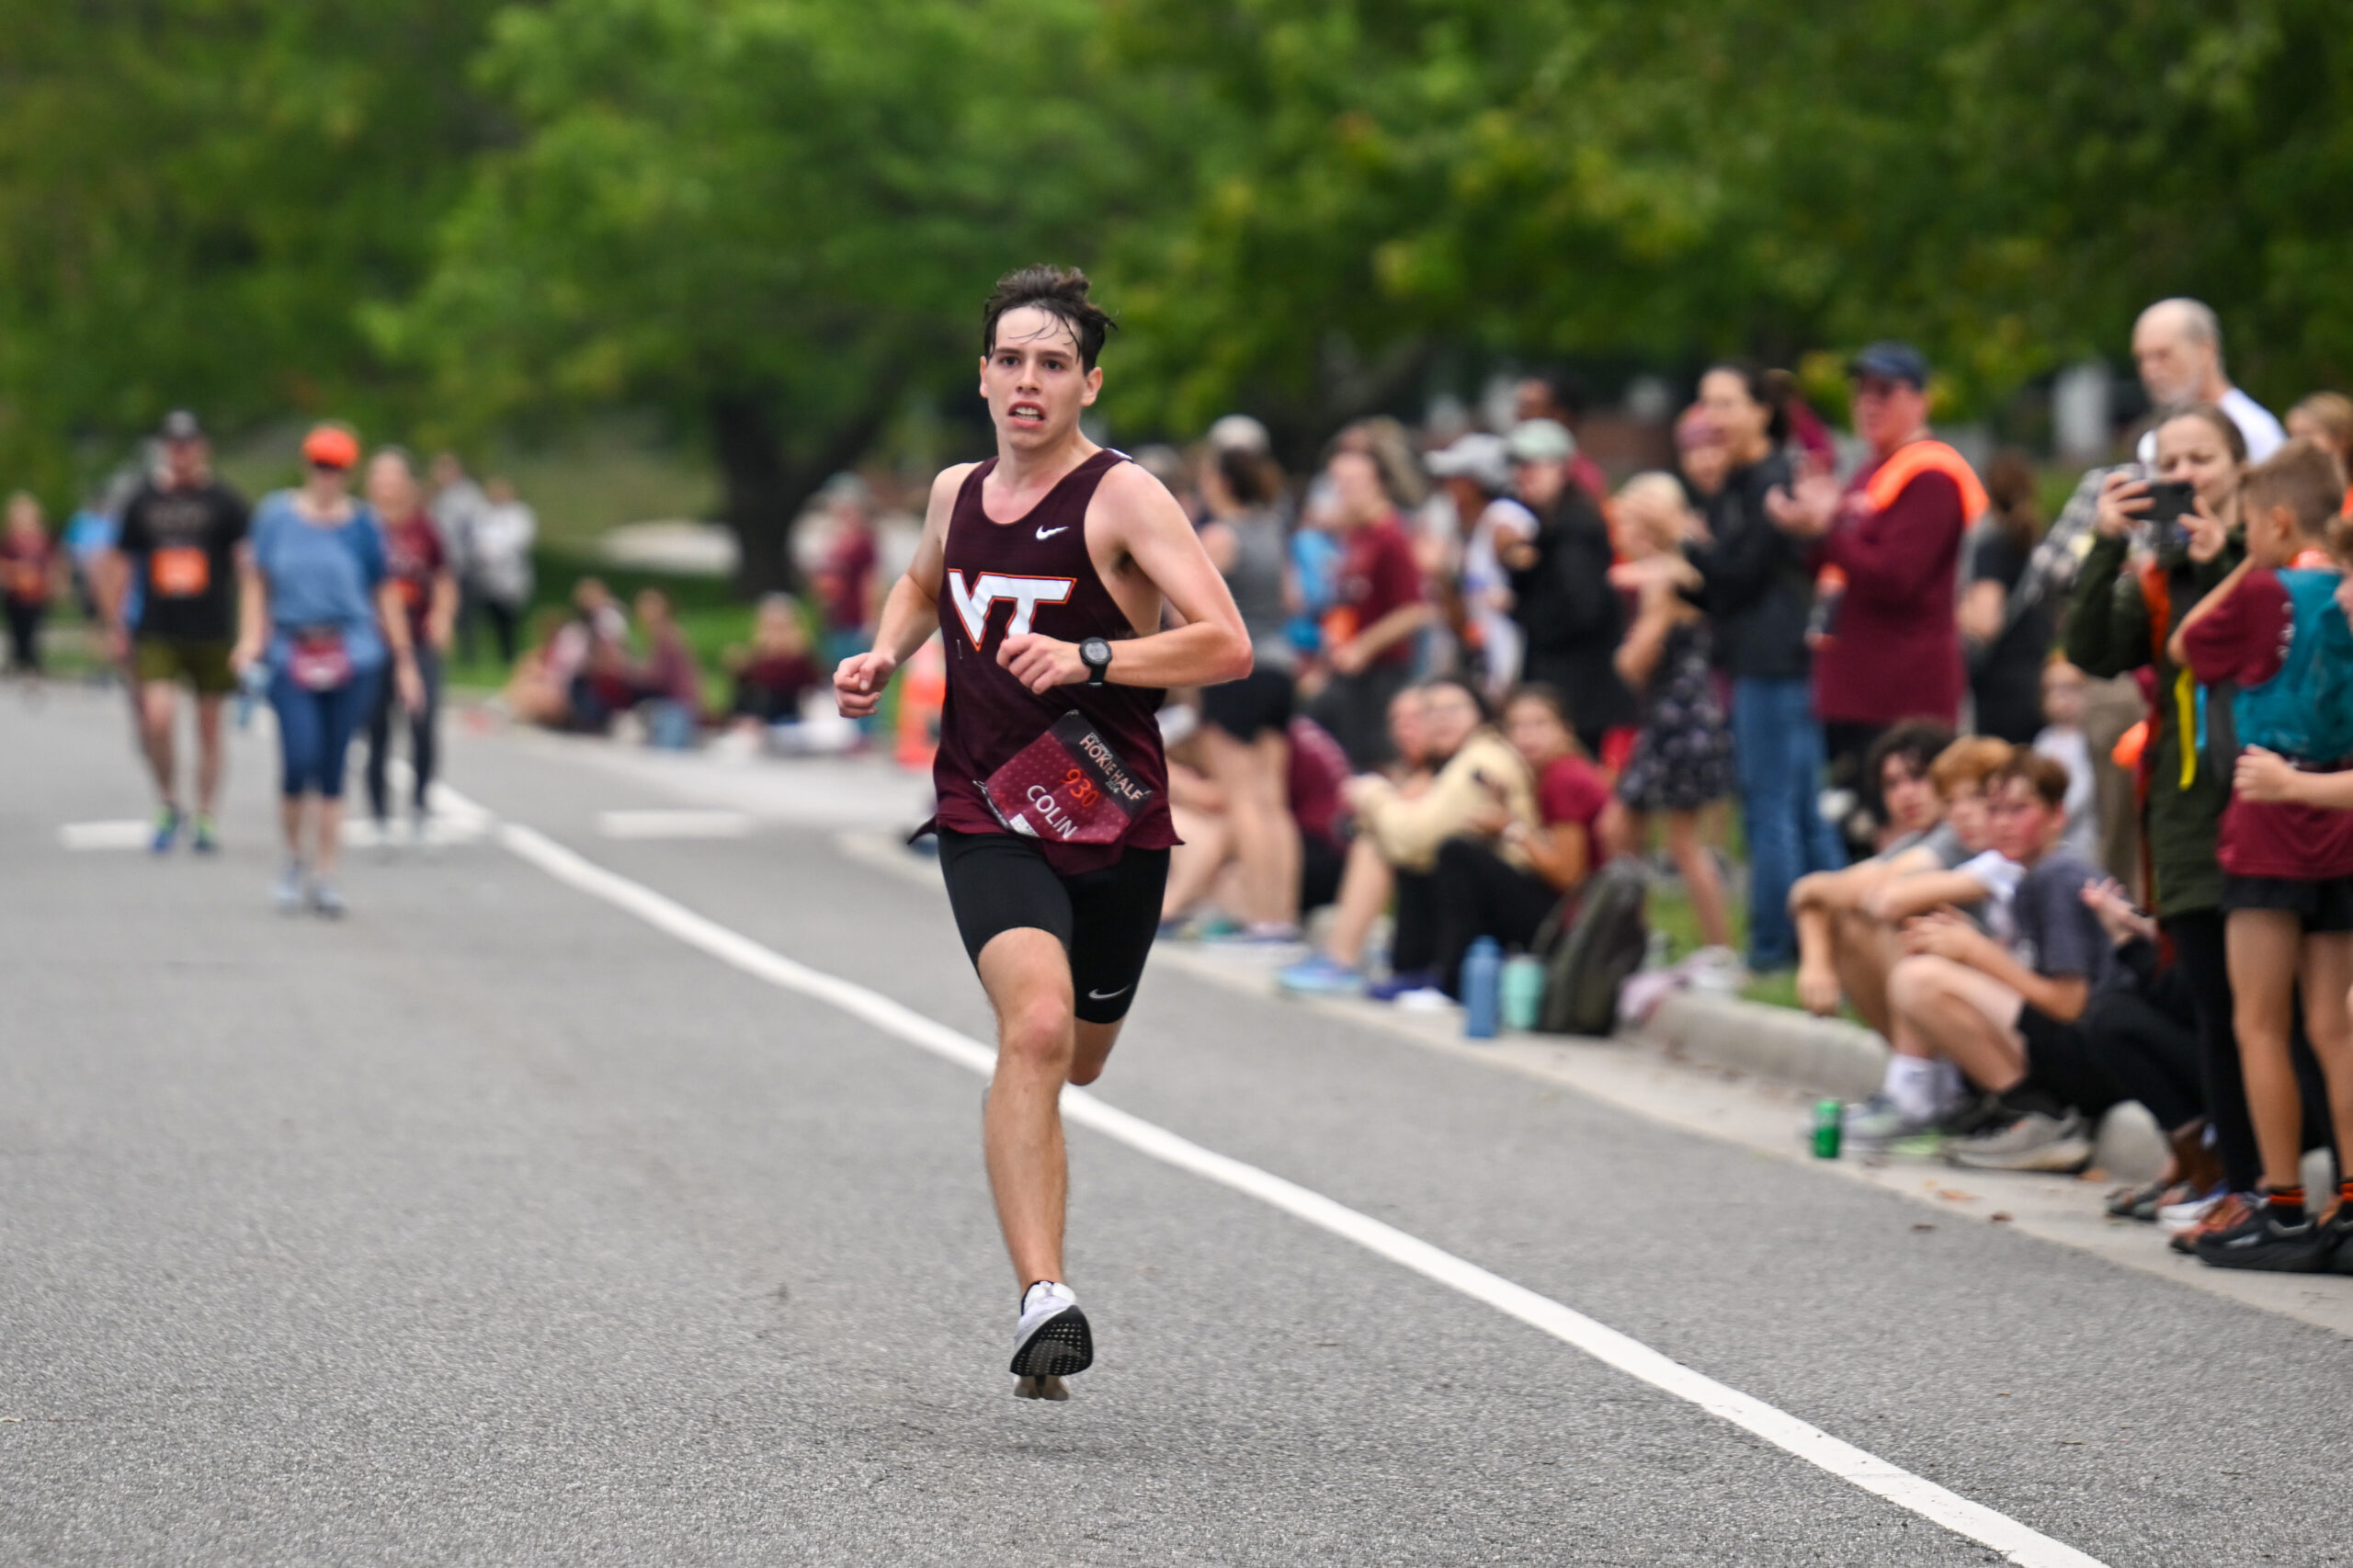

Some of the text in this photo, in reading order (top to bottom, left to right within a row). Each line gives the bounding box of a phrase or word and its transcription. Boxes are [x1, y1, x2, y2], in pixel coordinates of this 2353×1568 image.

[948, 568, 1077, 652] VT
[1060, 768, 1099, 807] 930
[1079, 734, 1118, 776] HOKIE
[1109, 769, 1143, 800] HALF
[1027, 785, 1078, 839] COLIN
